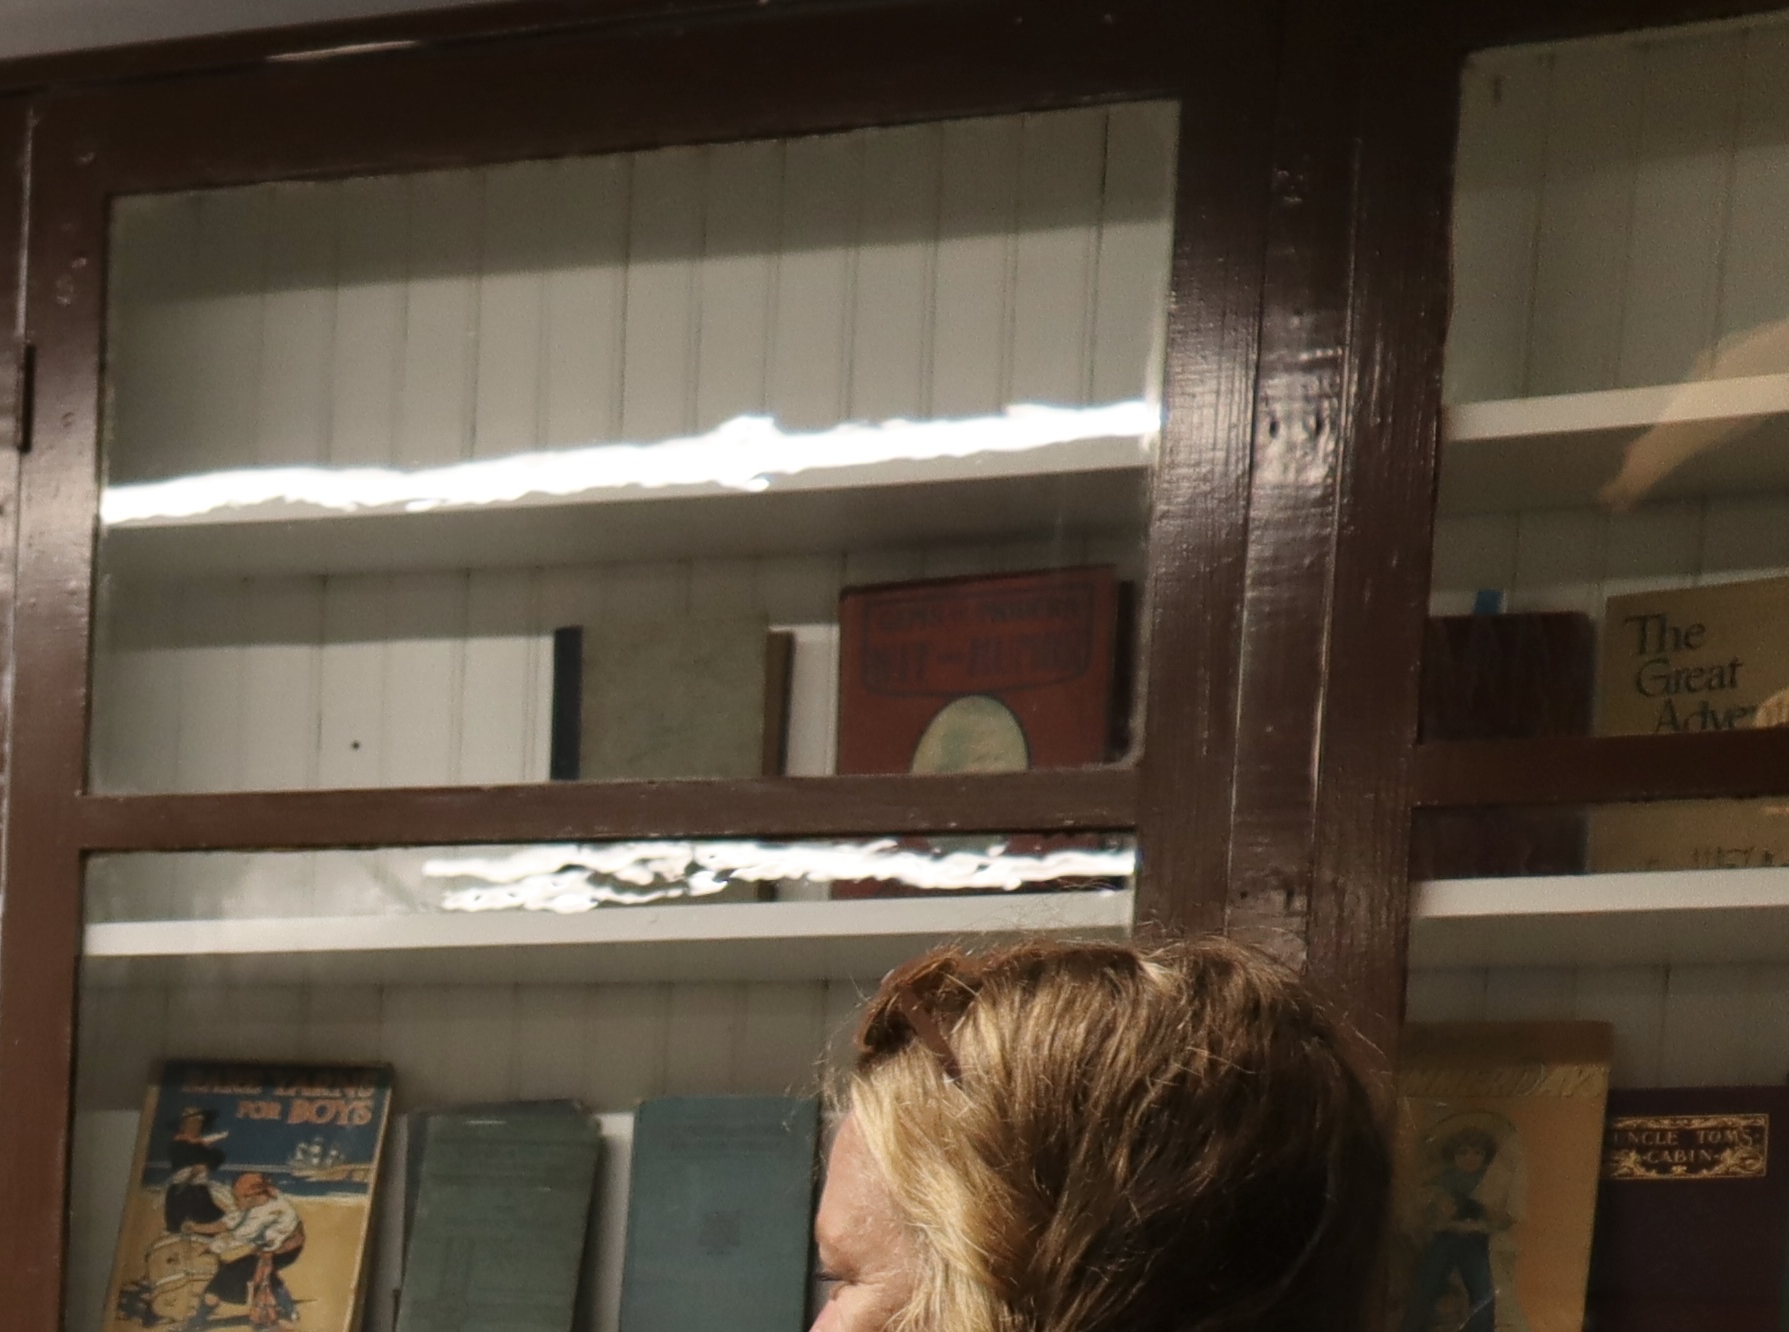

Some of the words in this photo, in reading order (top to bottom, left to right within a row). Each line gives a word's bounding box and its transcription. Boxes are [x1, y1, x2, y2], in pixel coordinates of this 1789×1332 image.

[1624, 613, 1706, 654] The
[1636, 656, 1744, 697] Great
[235, 1100, 282, 1120] FOR
[286, 1097, 374, 1126] BOYS
